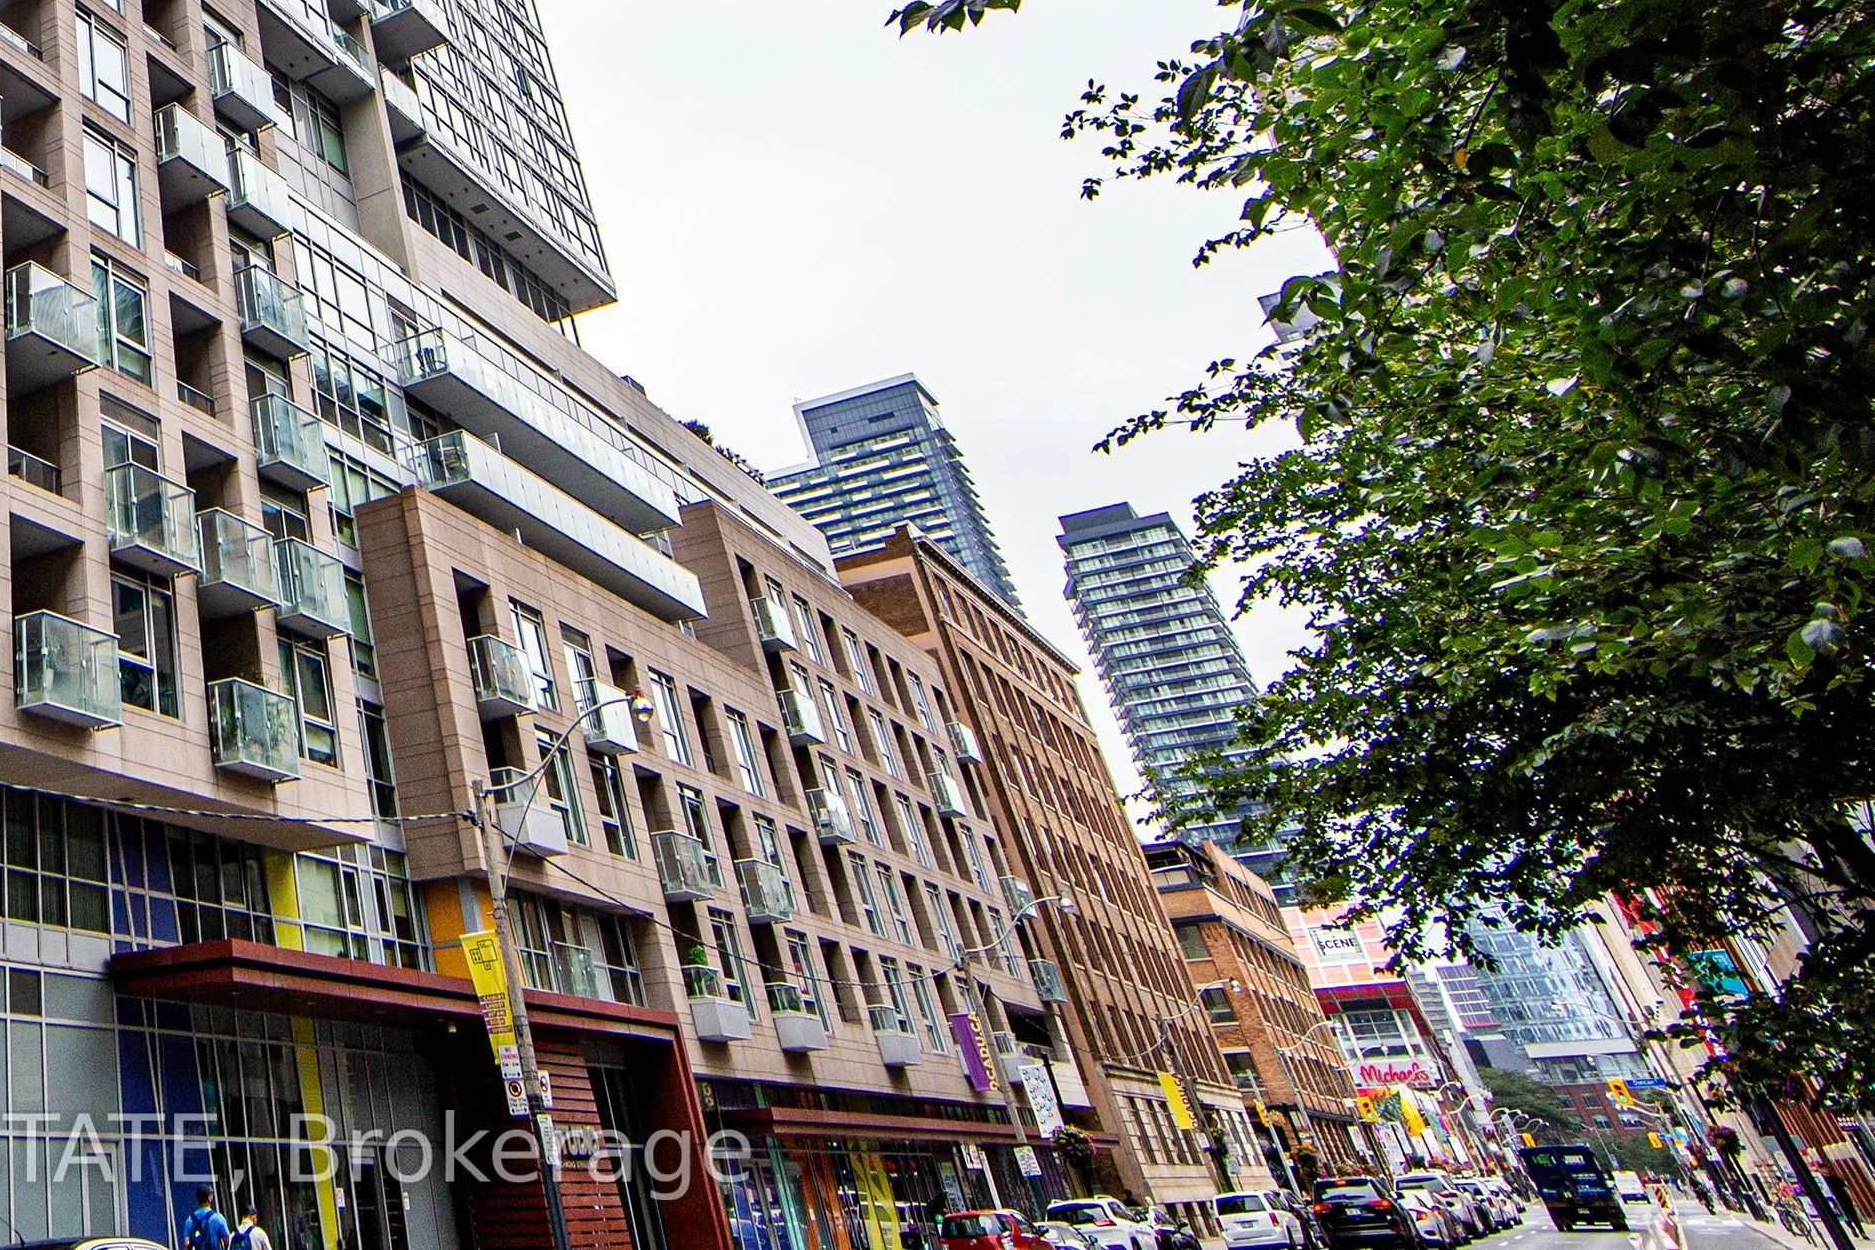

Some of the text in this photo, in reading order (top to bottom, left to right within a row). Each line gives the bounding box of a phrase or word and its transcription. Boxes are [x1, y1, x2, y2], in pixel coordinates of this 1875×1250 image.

[1318, 937, 1356, 950] SCENE
[968, 1012, 999, 1091] OCADU.CA
[1359, 1061, 1430, 1083] Michaels
